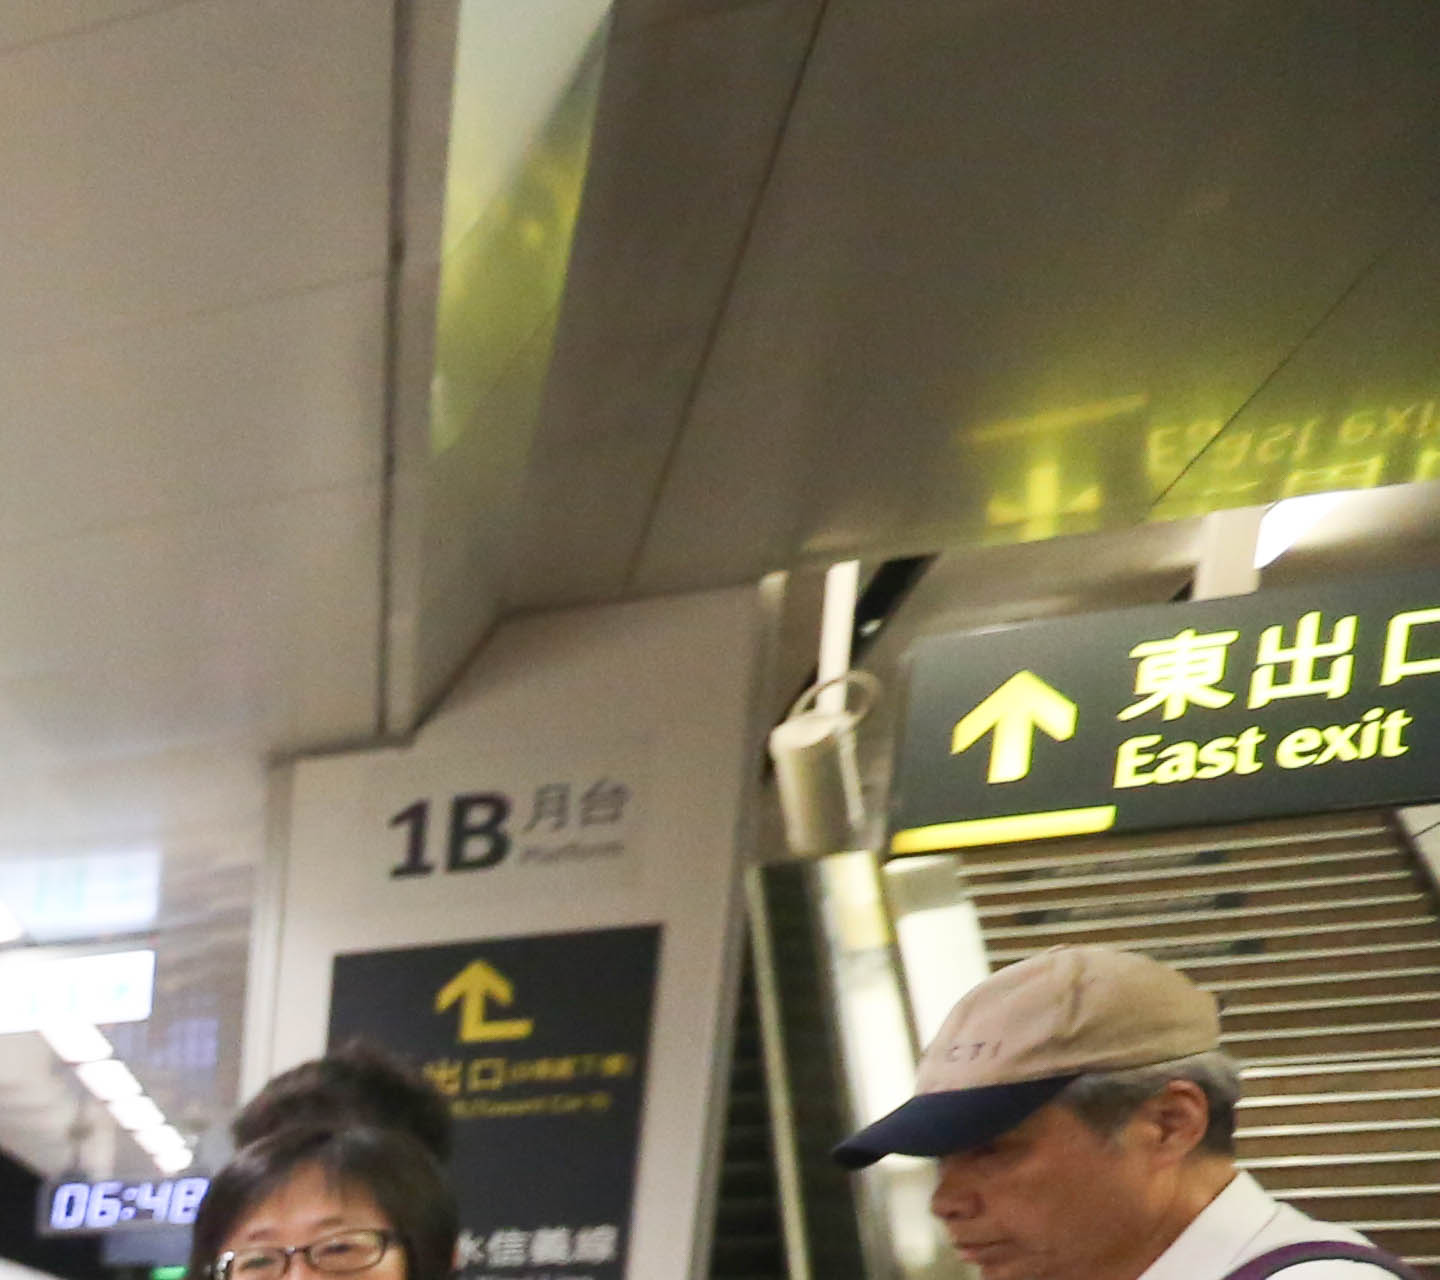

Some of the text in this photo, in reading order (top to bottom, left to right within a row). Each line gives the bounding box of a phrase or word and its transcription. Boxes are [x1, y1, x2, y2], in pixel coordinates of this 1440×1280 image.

[1116, 608, 1440, 722] 東出口
[1112, 706, 1414, 790] East exit
[387, 790, 513, 879] 1B
[50, 1177, 211, 1230] 06:48
